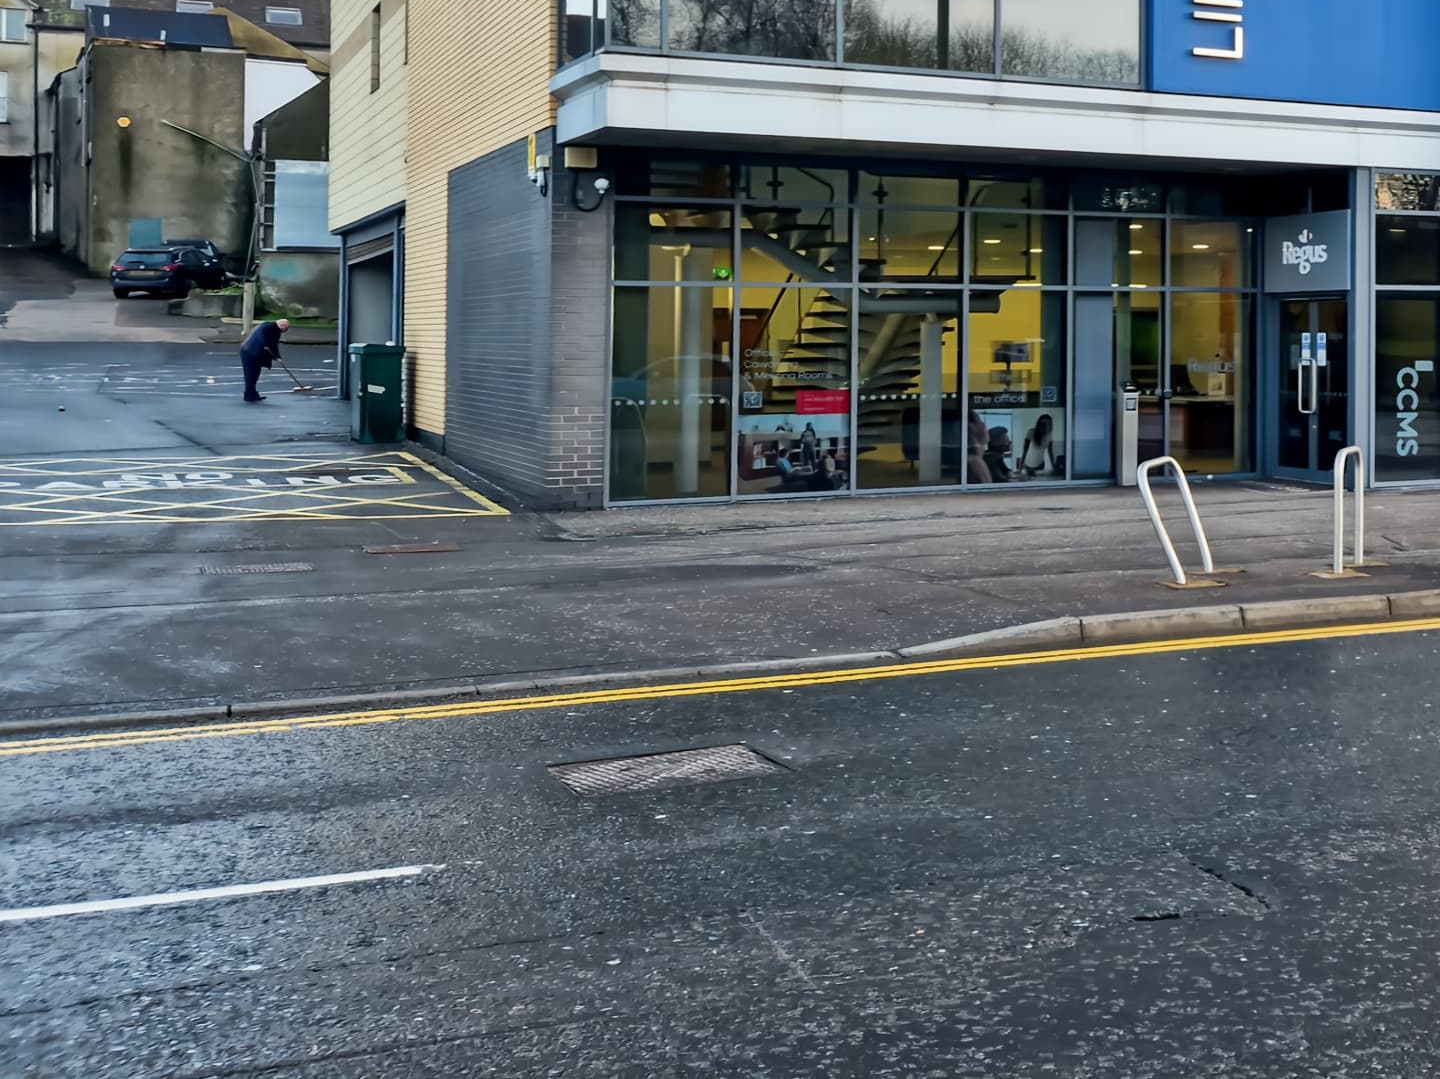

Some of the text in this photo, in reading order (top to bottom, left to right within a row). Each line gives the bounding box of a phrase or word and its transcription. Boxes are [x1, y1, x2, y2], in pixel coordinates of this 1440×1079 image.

[1282, 239, 1329, 275] Regus
[1396, 366, 1420, 457] CCMS
[120, 471, 234, 481] NO
